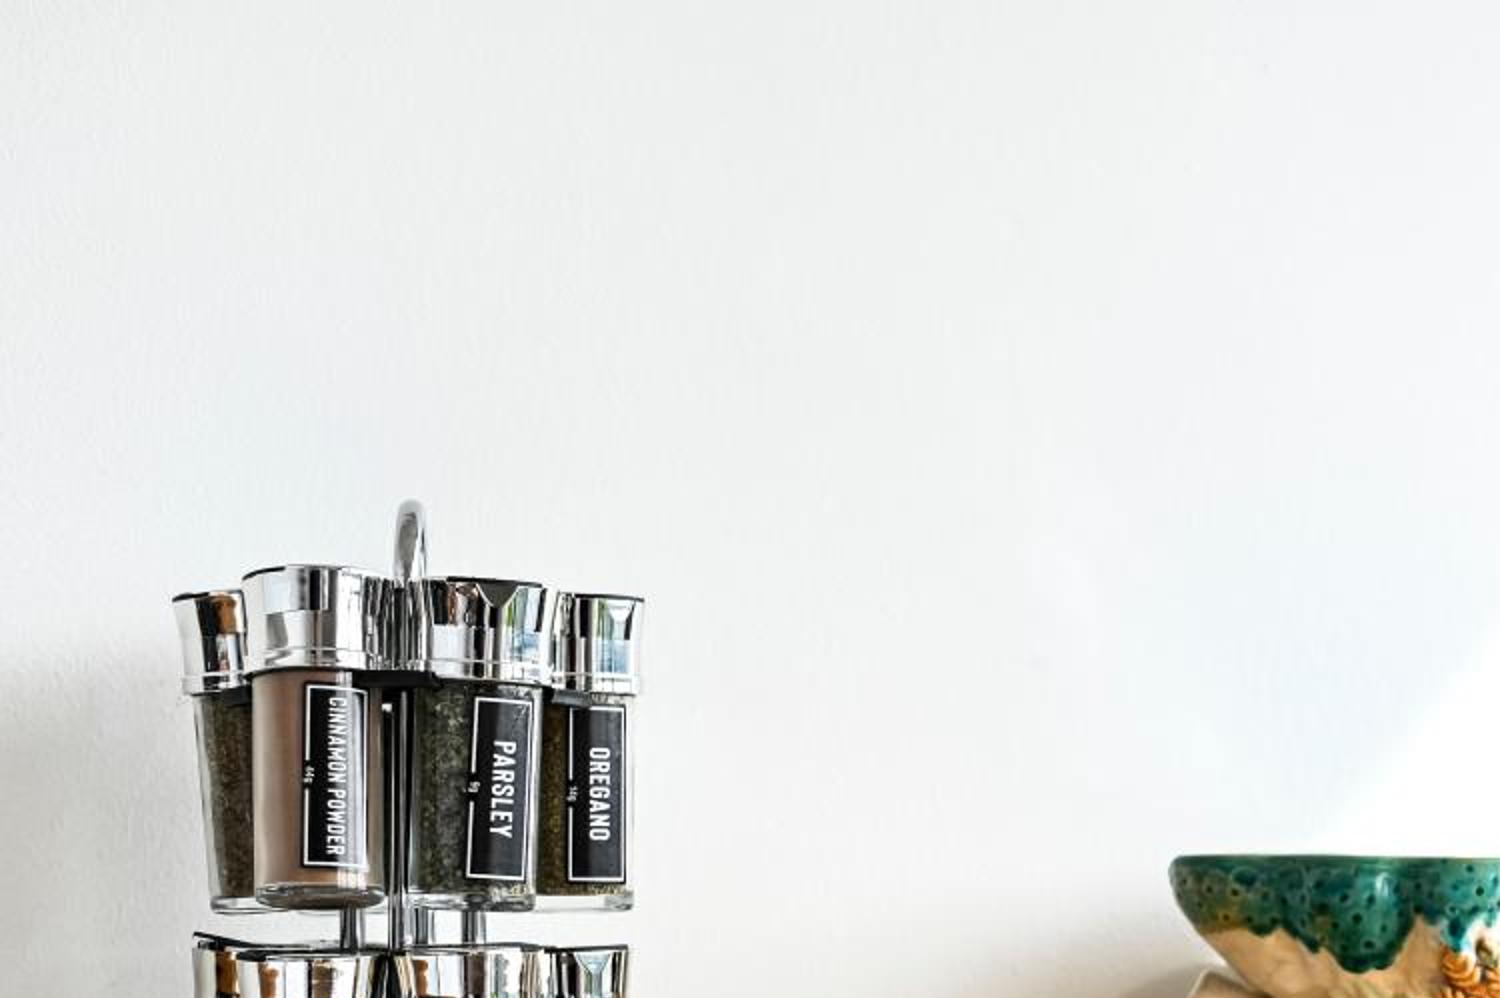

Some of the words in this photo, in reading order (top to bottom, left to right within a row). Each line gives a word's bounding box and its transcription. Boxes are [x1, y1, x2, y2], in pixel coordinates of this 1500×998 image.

[327, 697, 348, 783] CINNAMON
[326, 788, 347, 856] POWDER
[489, 740, 517, 839] PARSLEY
[588, 747, 611, 842] OREGANO
